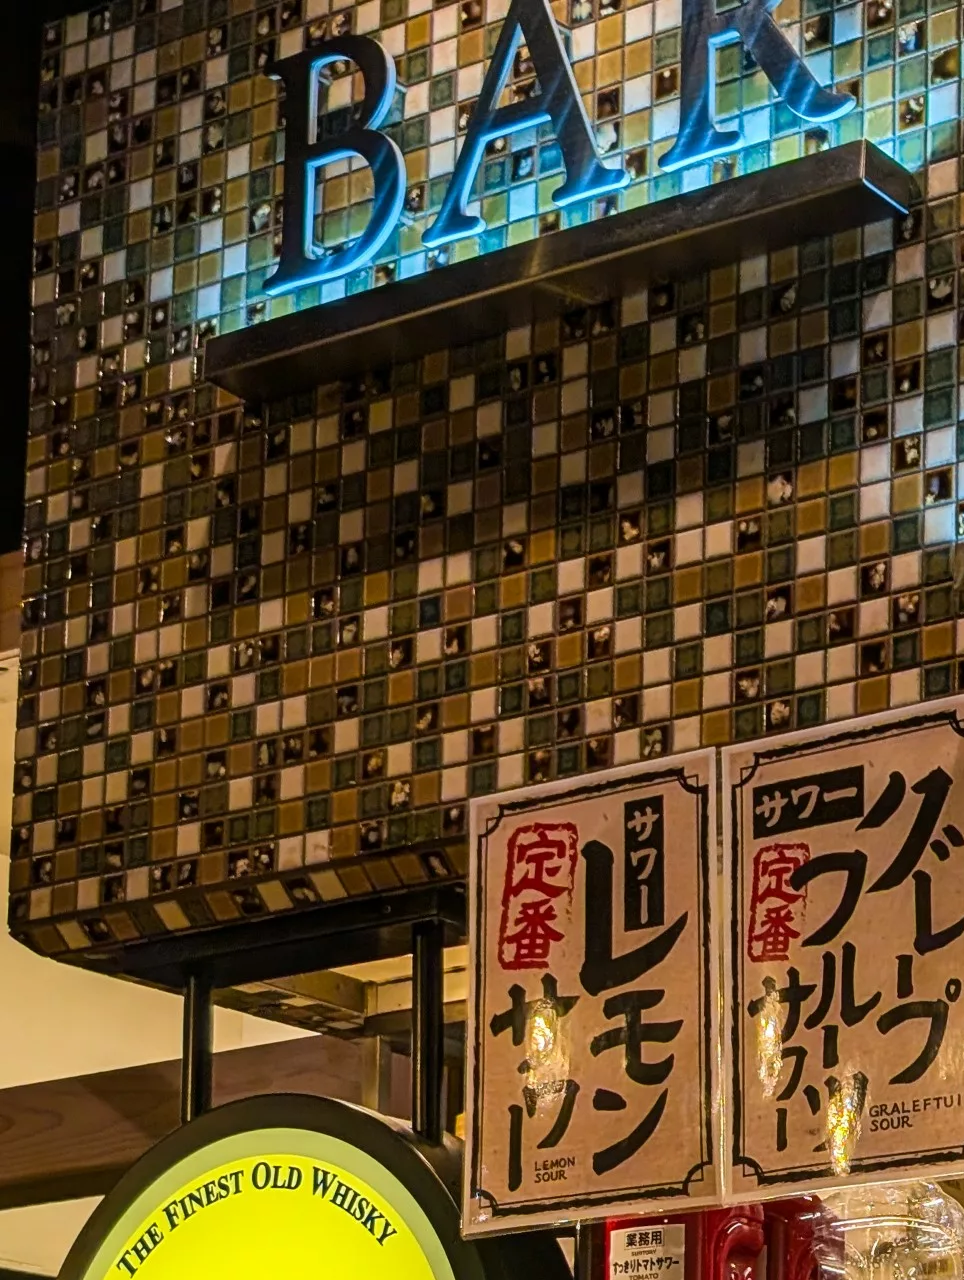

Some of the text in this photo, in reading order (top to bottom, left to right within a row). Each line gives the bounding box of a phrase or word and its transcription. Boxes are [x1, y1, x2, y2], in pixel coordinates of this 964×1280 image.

[262, 0, 857, 297] BAR
[756, 782, 859, 829] サワー
[502, 828, 573, 968] 定番
[626, 808, 661, 924] サワー
[752, 845, 809, 961] 定番
[579, 839, 689, 1176] レモン
[534, 1156, 576, 1172] LEMON
[534, 1169, 568, 1184] SOUR
[869, 1115, 913, 1133] SOUR
[116, 1160, 398, 1280] THE FINEST OLD WHISKY
[626, 1230, 663, 1248] 業務用
